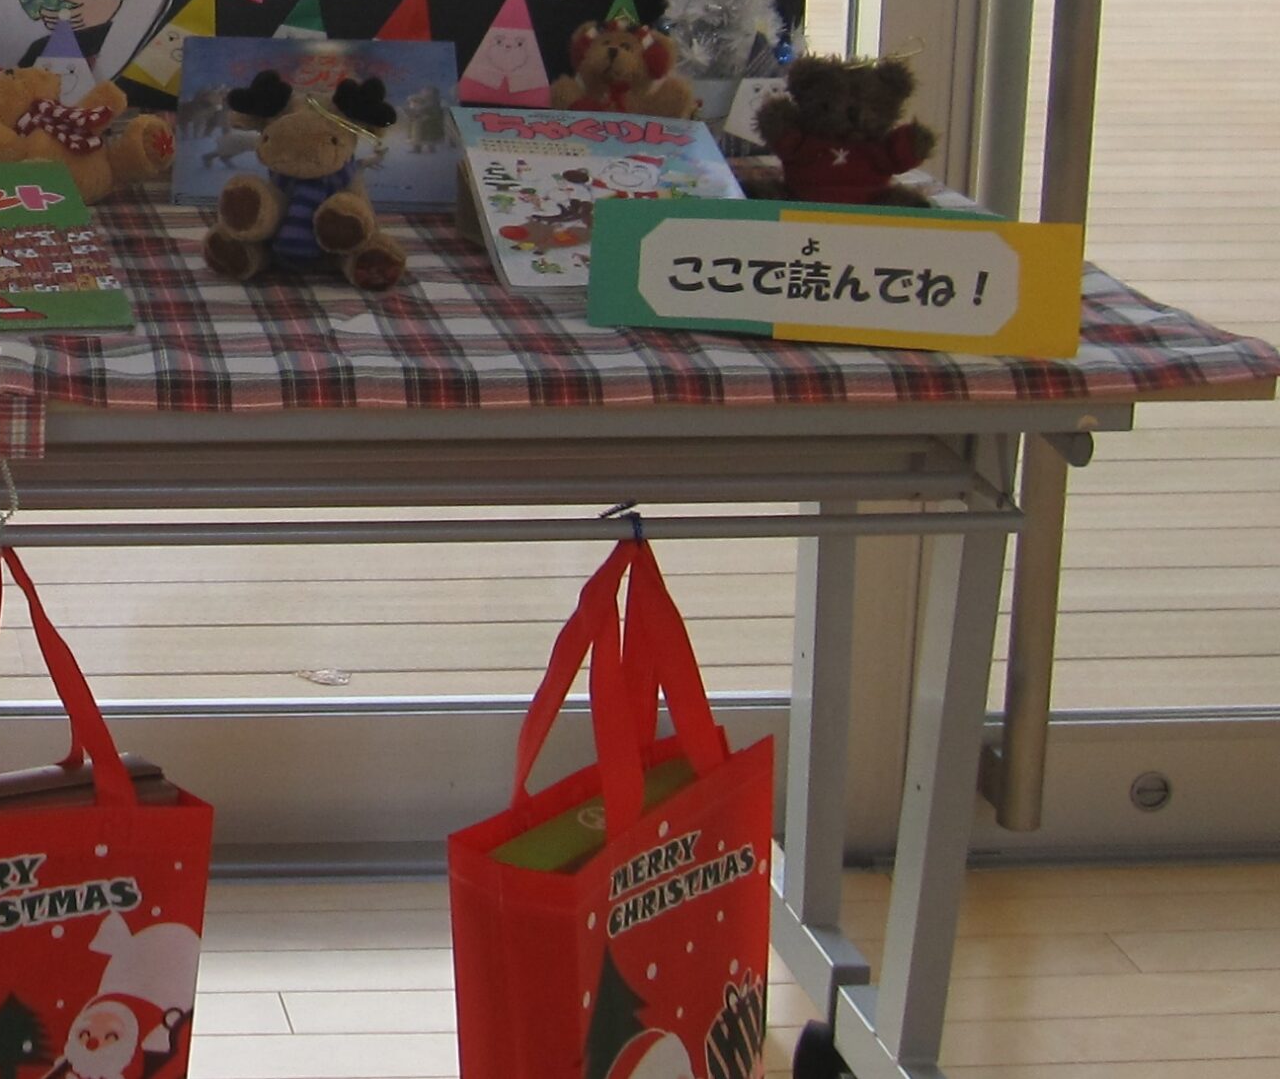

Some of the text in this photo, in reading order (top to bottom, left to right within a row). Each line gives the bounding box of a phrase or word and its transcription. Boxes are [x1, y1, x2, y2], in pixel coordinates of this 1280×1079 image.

[668, 256, 989, 307] ここで読んでね！
[607, 844, 756, 938] CHRISTMAS
[609, 830, 701, 901] MERRY
